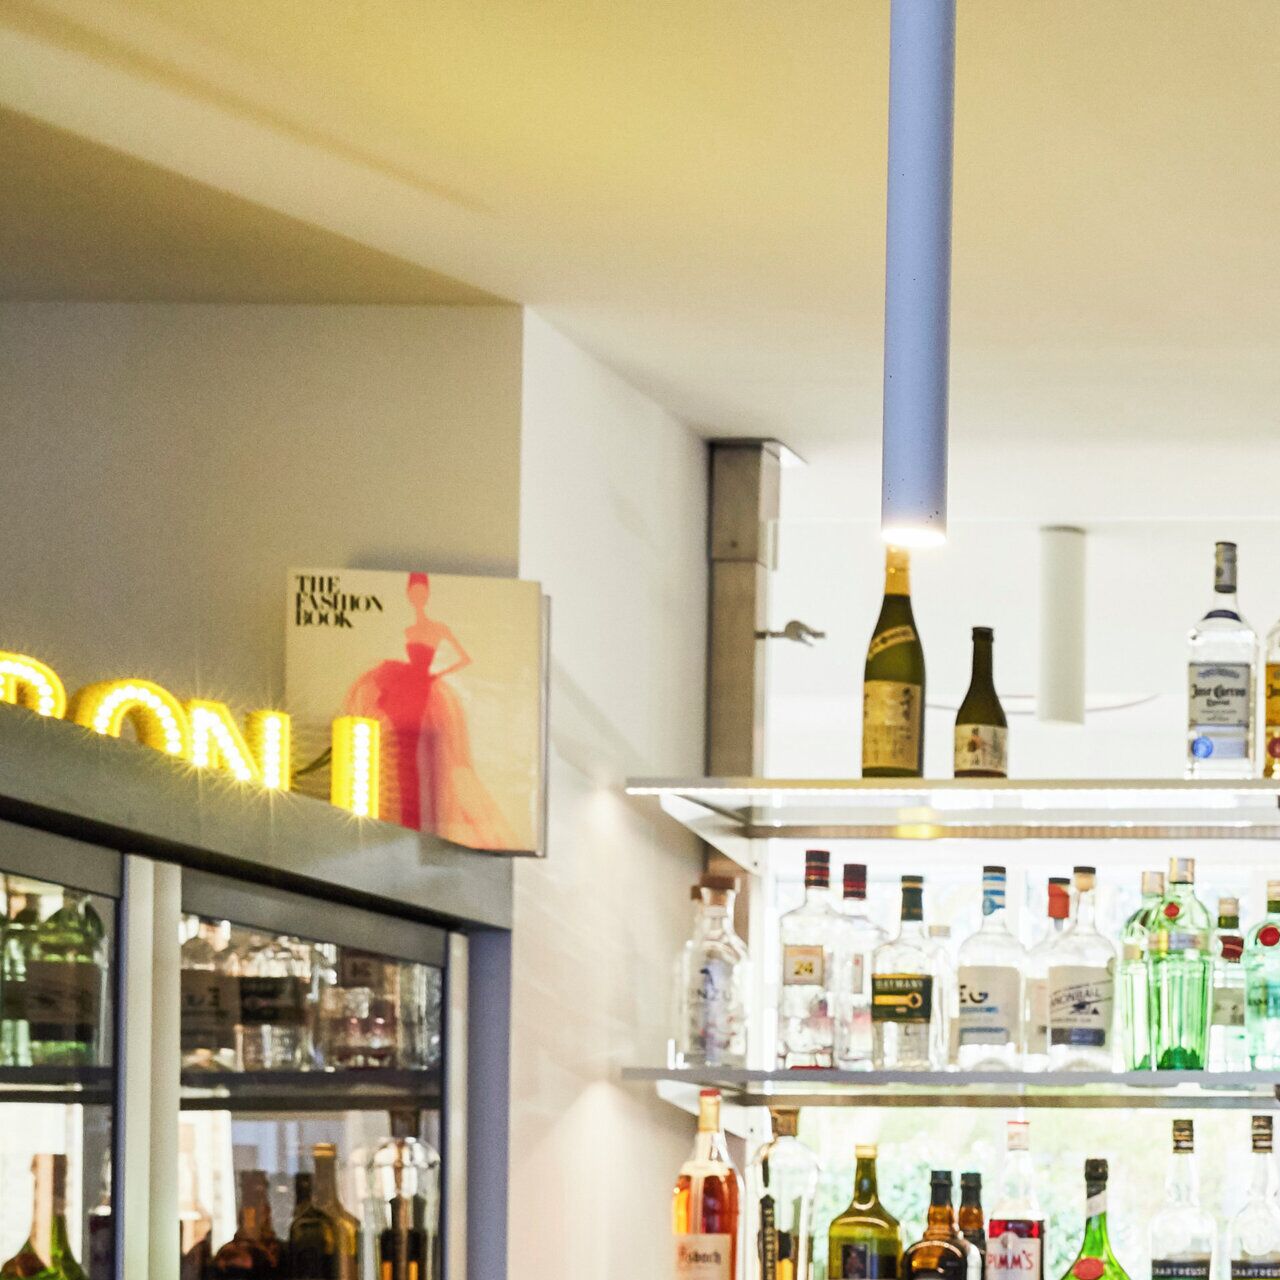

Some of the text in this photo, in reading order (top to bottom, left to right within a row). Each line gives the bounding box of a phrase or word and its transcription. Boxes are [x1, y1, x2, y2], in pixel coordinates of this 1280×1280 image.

[295, 574, 340, 594] THE
[295, 592, 384, 613] FASHION
[295, 609, 353, 629] BOOK
[793, 960, 814, 976] 24
[987, 1250, 1034, 1271] PIMM'S
